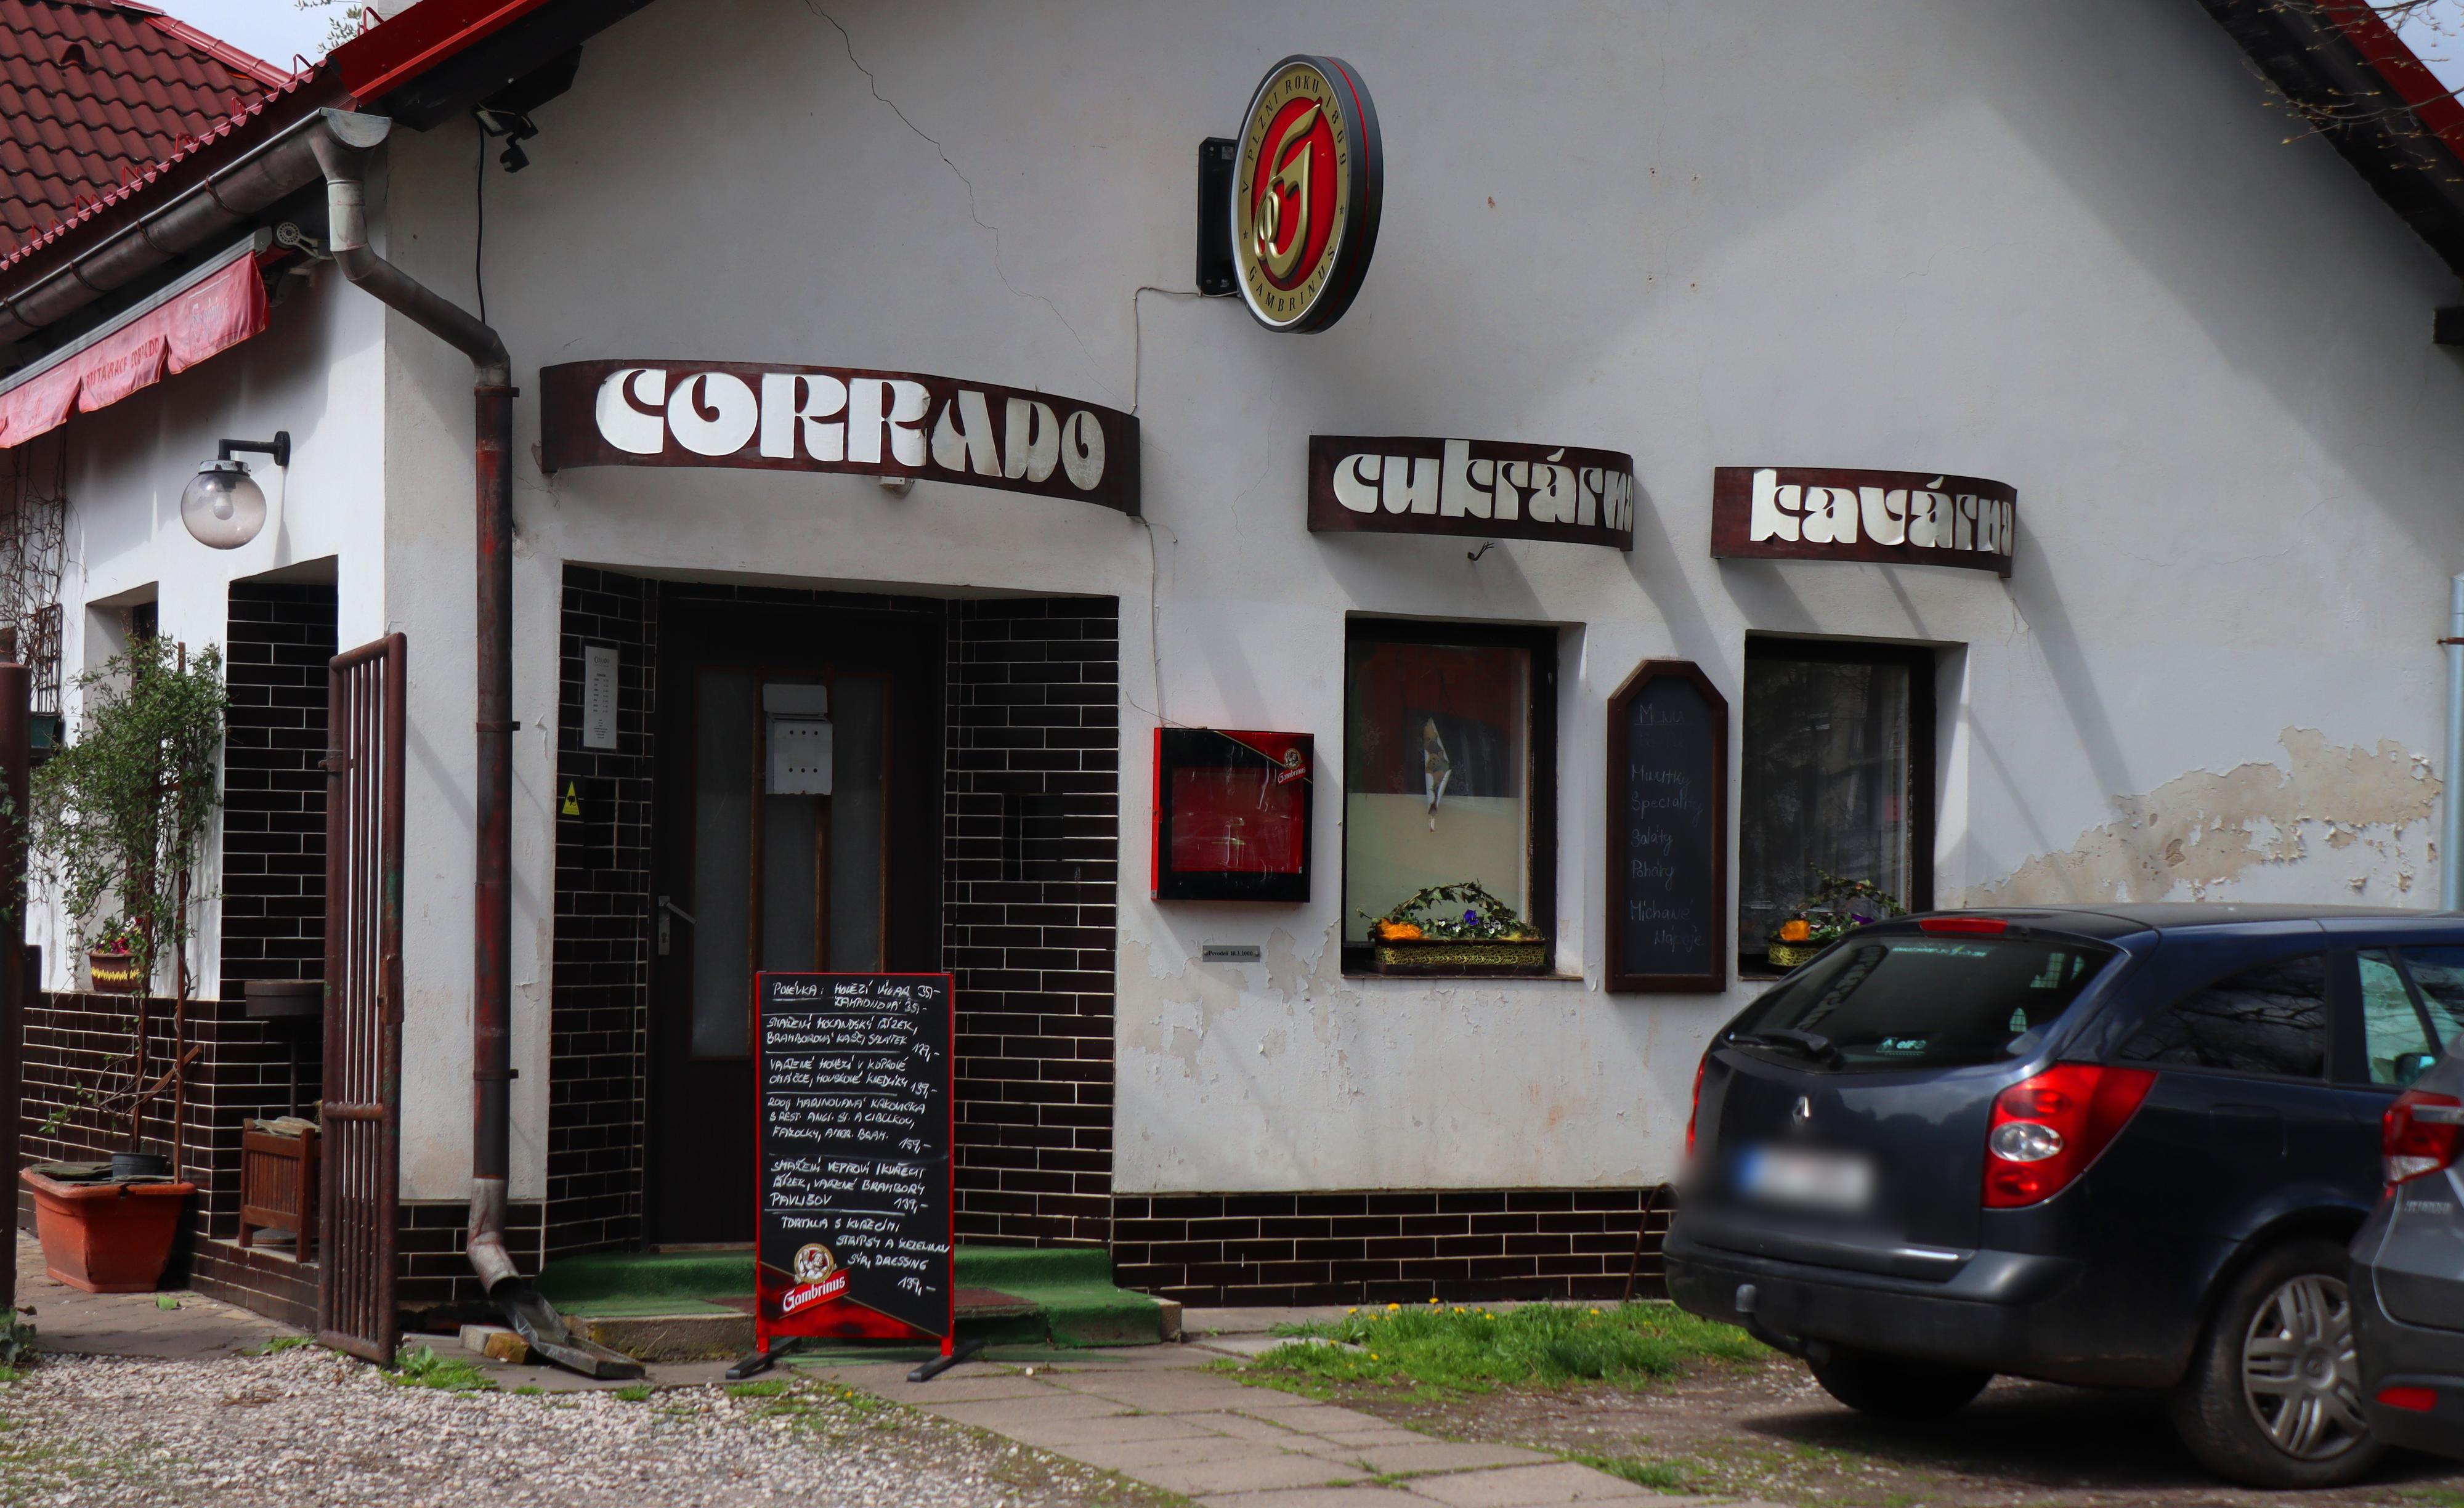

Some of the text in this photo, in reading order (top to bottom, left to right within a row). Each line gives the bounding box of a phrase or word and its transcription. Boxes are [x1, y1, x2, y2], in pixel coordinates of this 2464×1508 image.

[1241, 75, 1347, 195] V PLZNI ROKU 1869
[1249, 245, 1335, 313] GAMBRINUS
[594, 368, 1106, 492] CORRADO
[1332, 439, 1633, 533] cukrárna
[1750, 468, 2012, 556] kavárna
[1278, 766, 1307, 784] Gambrinus
[782, 1275, 846, 1313] Gambrinus
